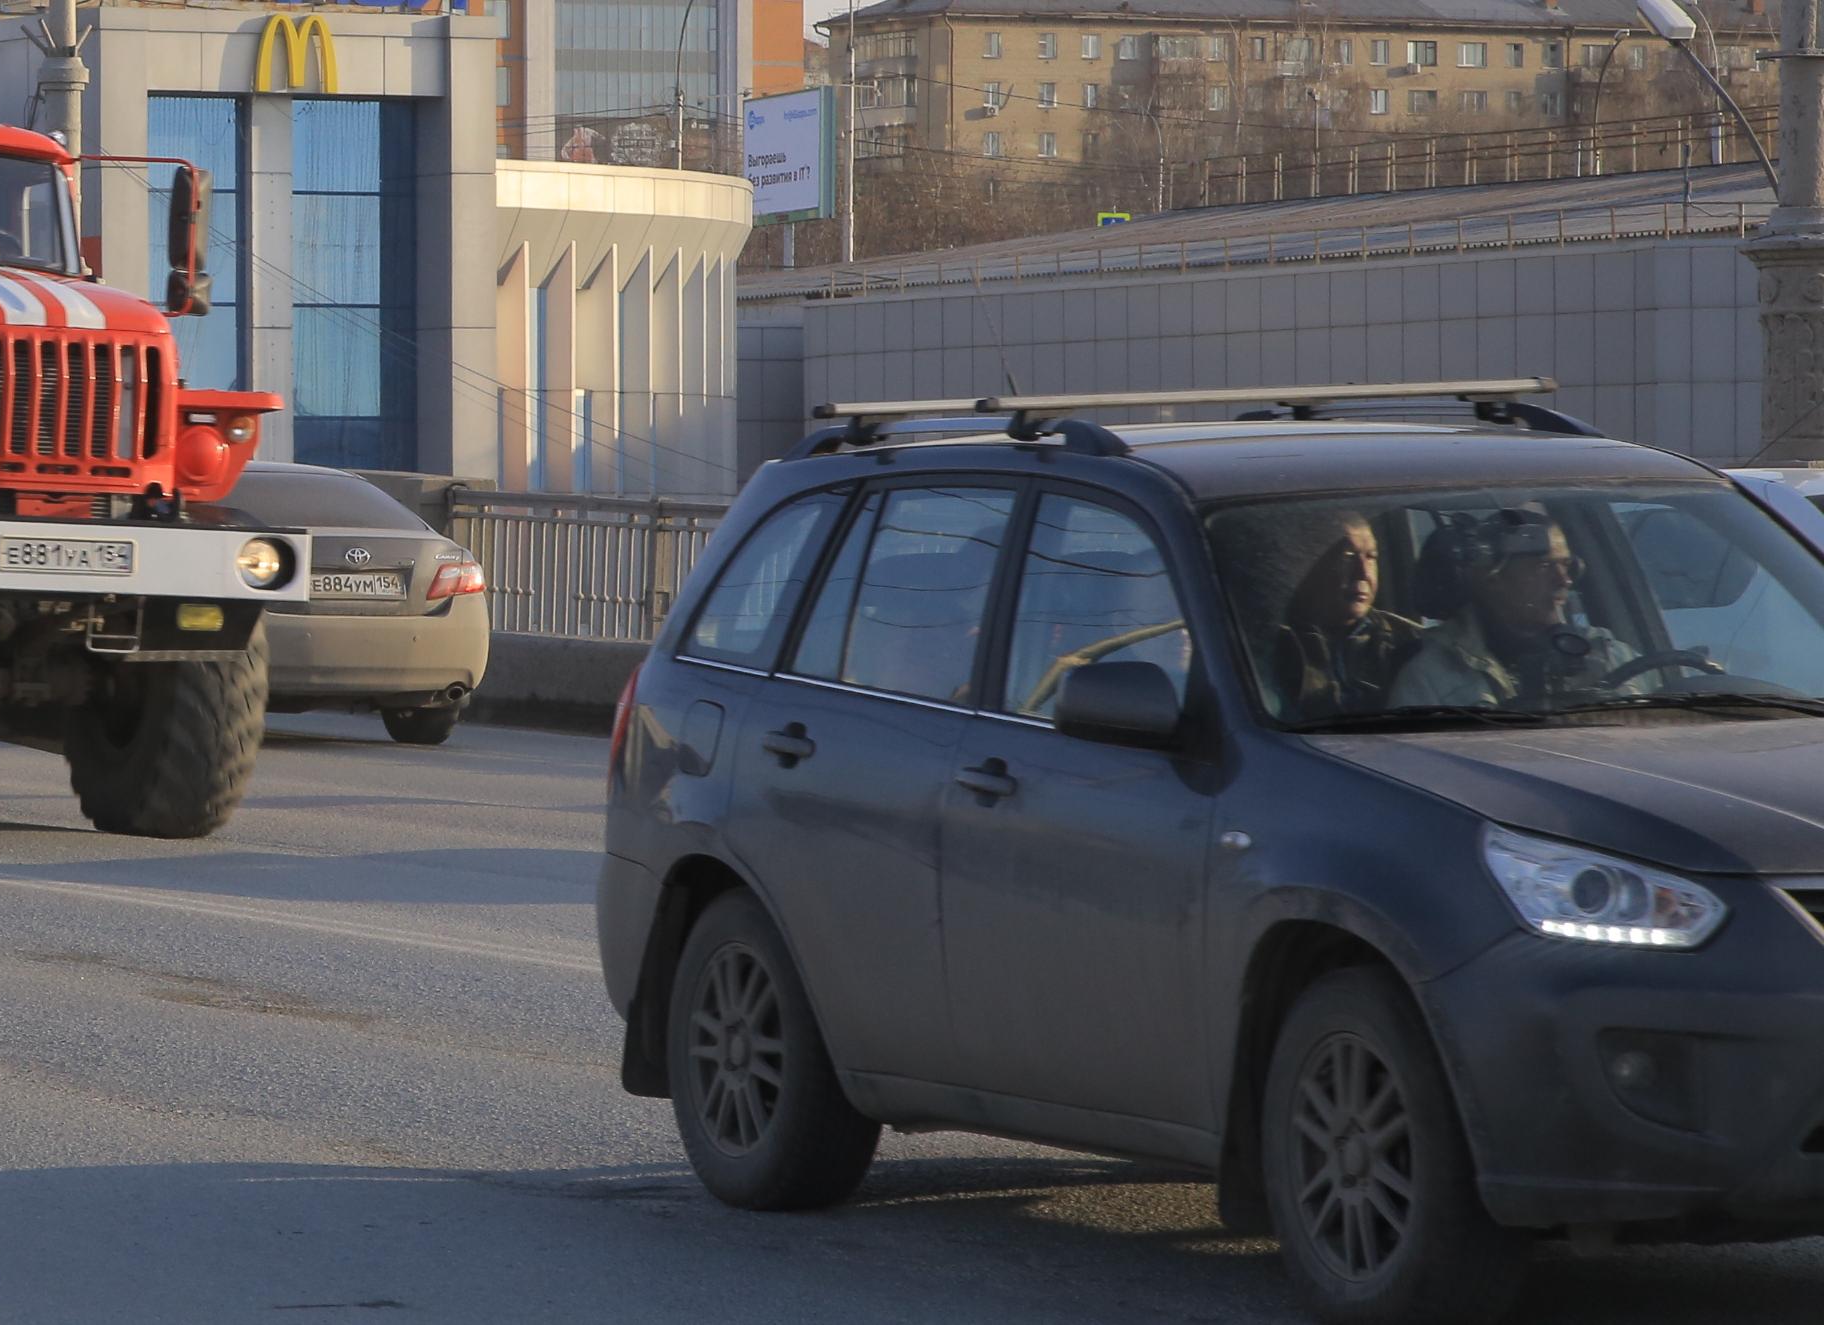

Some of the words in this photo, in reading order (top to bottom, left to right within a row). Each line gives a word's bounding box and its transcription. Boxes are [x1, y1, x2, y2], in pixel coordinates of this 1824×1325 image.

[7, 543, 92, 567] Е881УА
[312, 576, 374, 593] Е884УМ
[376, 575, 400, 589] 154
